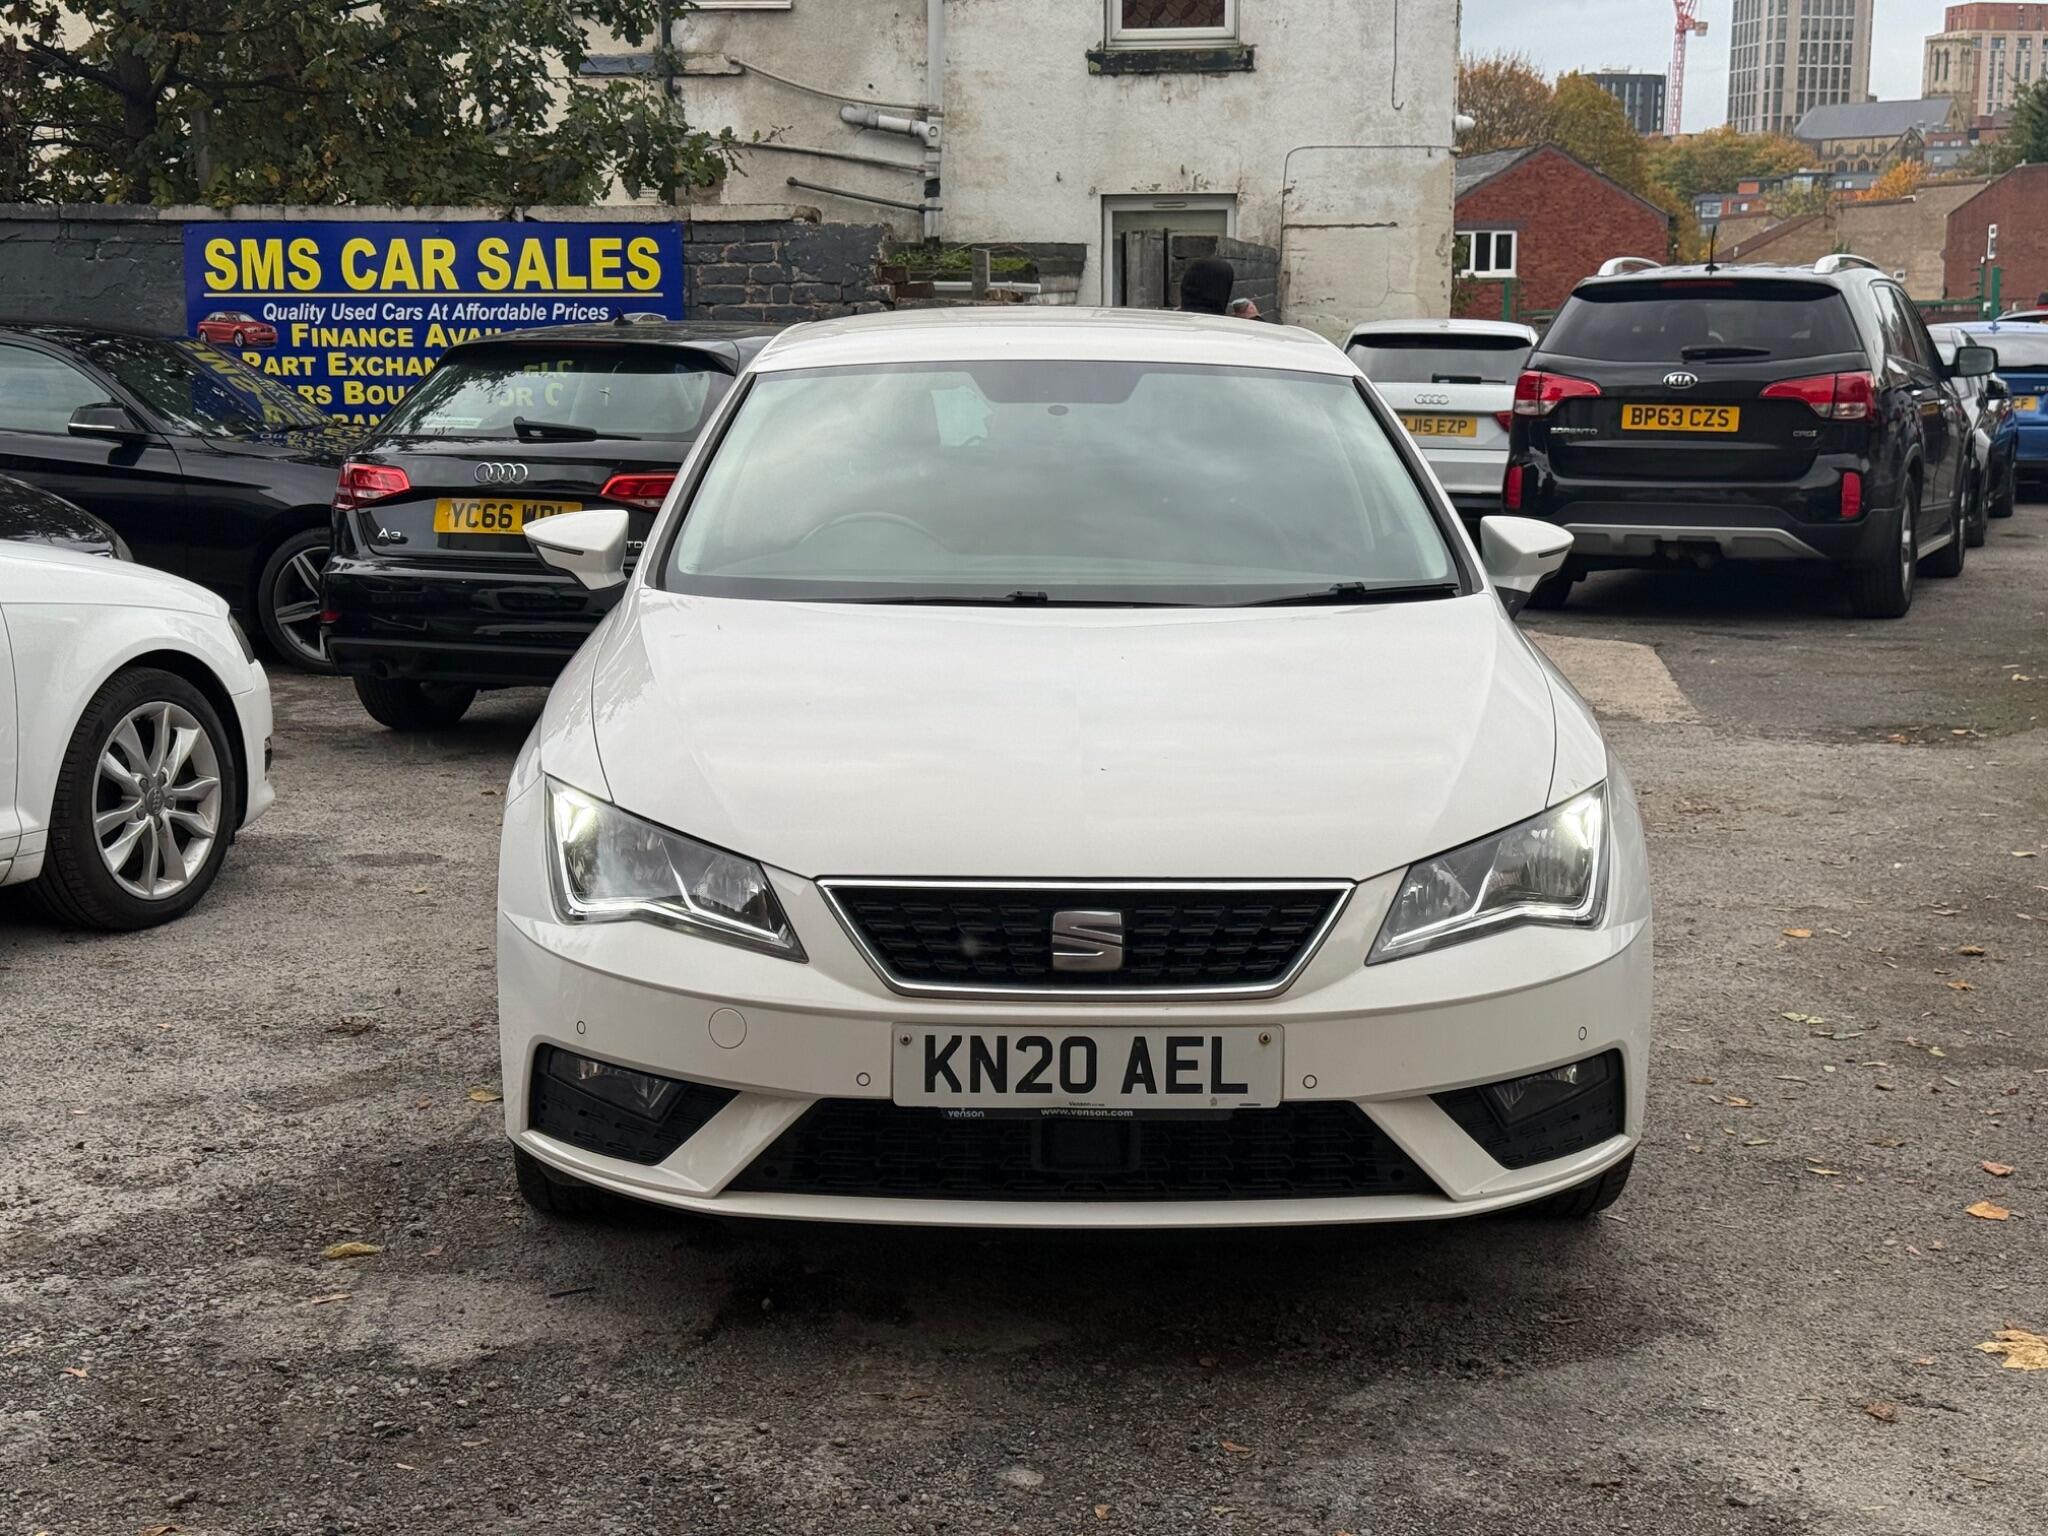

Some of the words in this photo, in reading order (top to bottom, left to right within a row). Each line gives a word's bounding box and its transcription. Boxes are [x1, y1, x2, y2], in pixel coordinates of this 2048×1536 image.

[204, 237, 322, 291] SMS
[341, 237, 459, 291] CAR
[477, 236, 662, 292] SALES
[262, 302, 326, 324] Quality
[331, 303, 377, 321] Used
[382, 303, 423, 321] Cars
[427, 303, 448, 321] At
[451, 303, 547, 321] Affordable
[552, 303, 609, 321] Prices
[291, 323, 414, 347] FINANCE
[328, 352, 440, 376] EXCHAN
[1437, 418, 1468, 434] EZP
[1630, 407, 1684, 427] BP63
[1689, 409, 1730, 427] CZS
[451, 502, 514, 529] YC66
[377, 527, 402, 540] A3
[924, 1034, 1098, 1094] KN20
[1120, 1035, 1249, 1095] AEL
